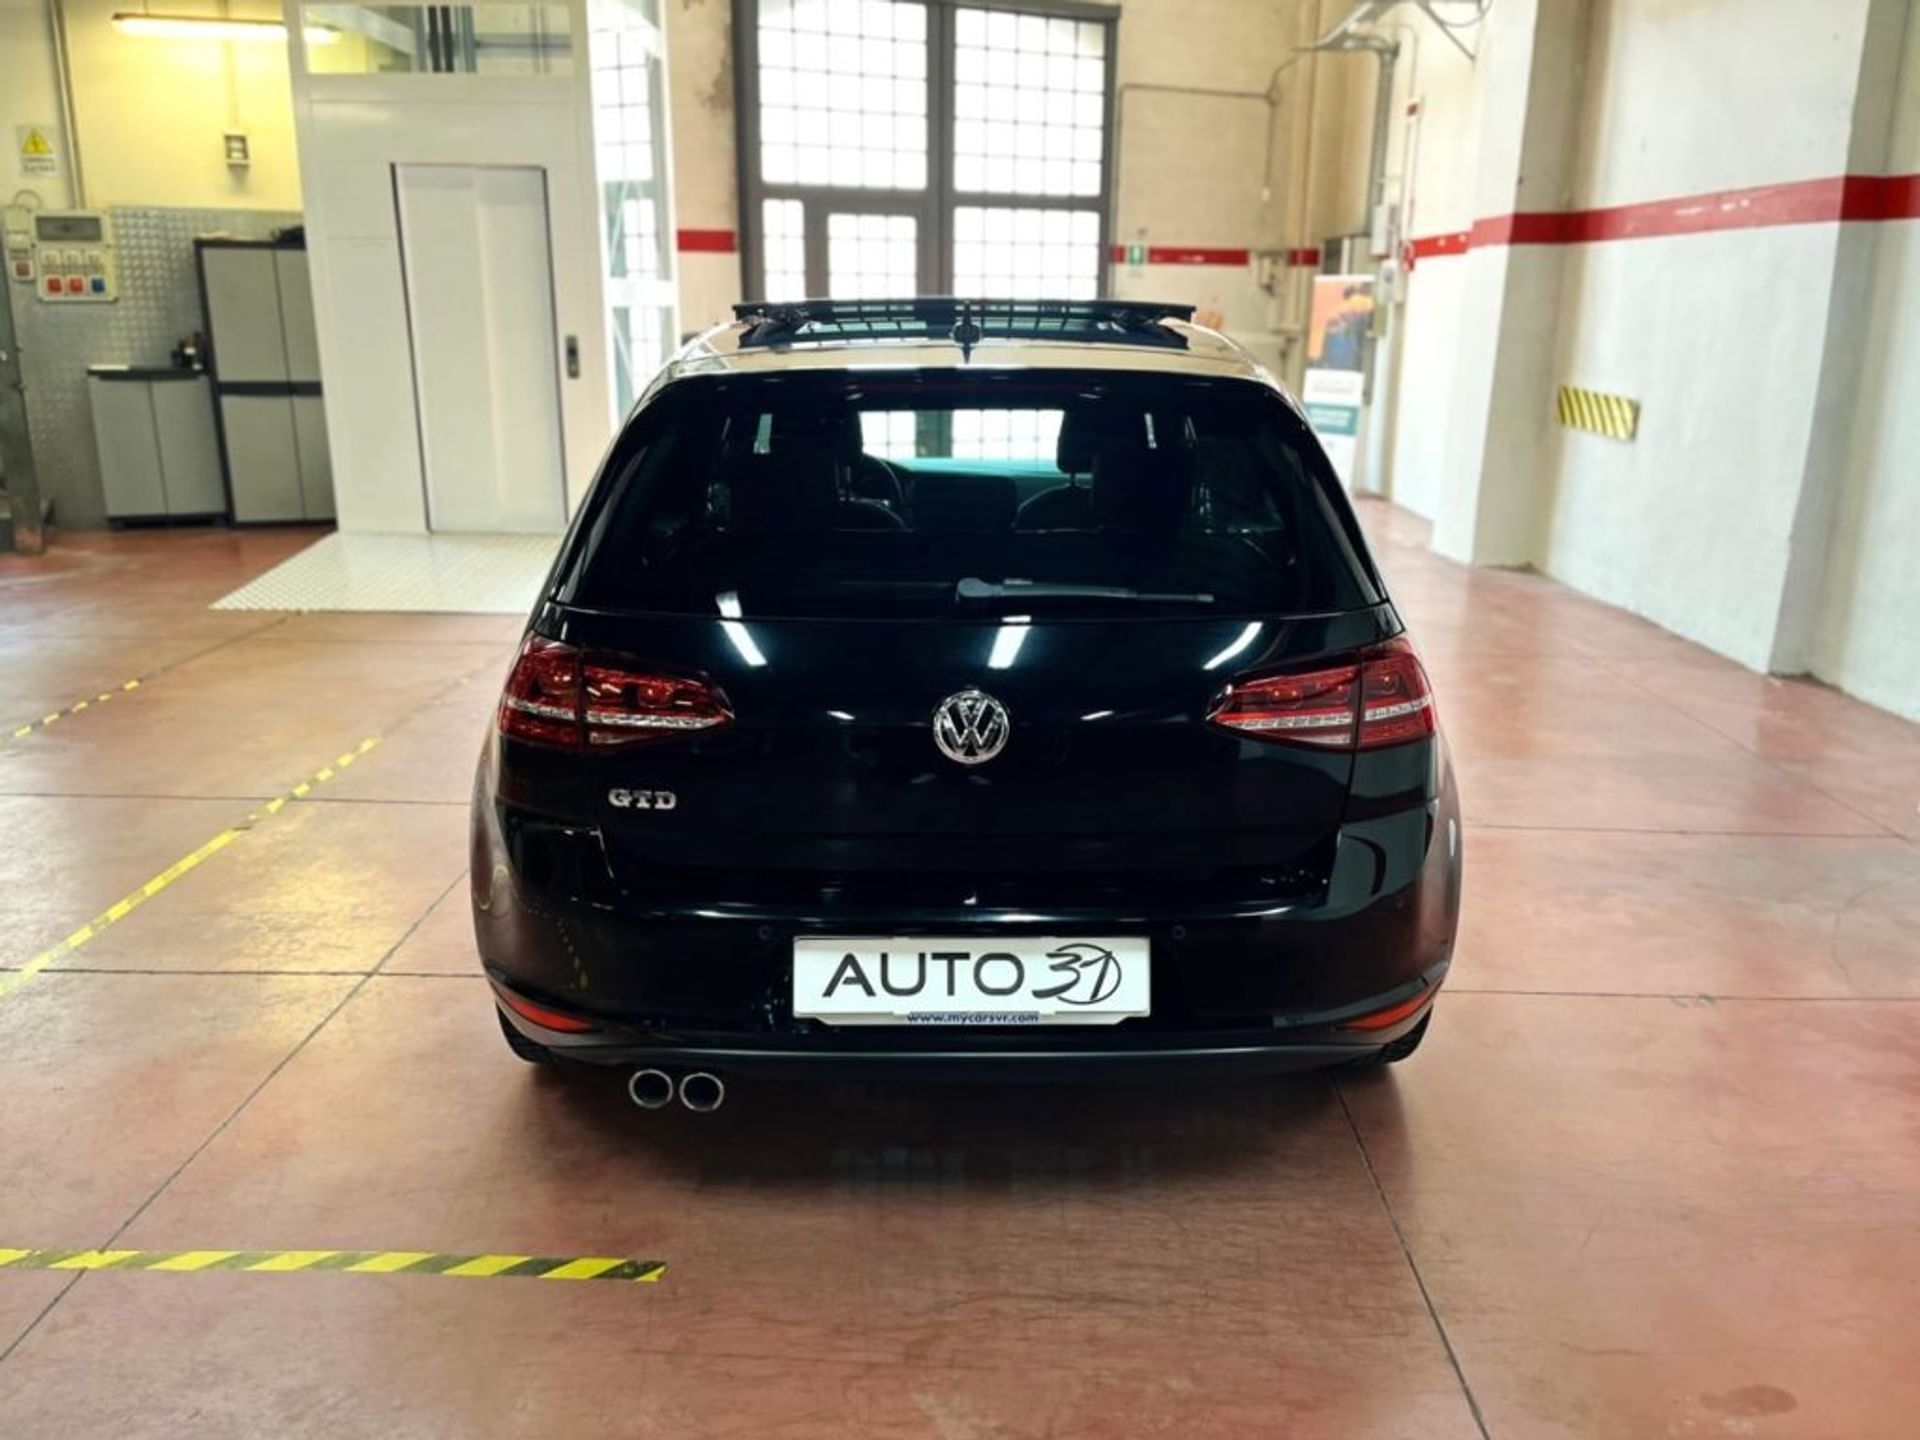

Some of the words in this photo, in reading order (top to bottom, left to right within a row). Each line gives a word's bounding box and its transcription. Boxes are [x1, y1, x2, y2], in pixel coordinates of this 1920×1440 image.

[608, 788, 677, 810] GTD
[822, 952, 1025, 997] AUTO
[907, 1012, 1039, 1025] www.mycarsvr.com
